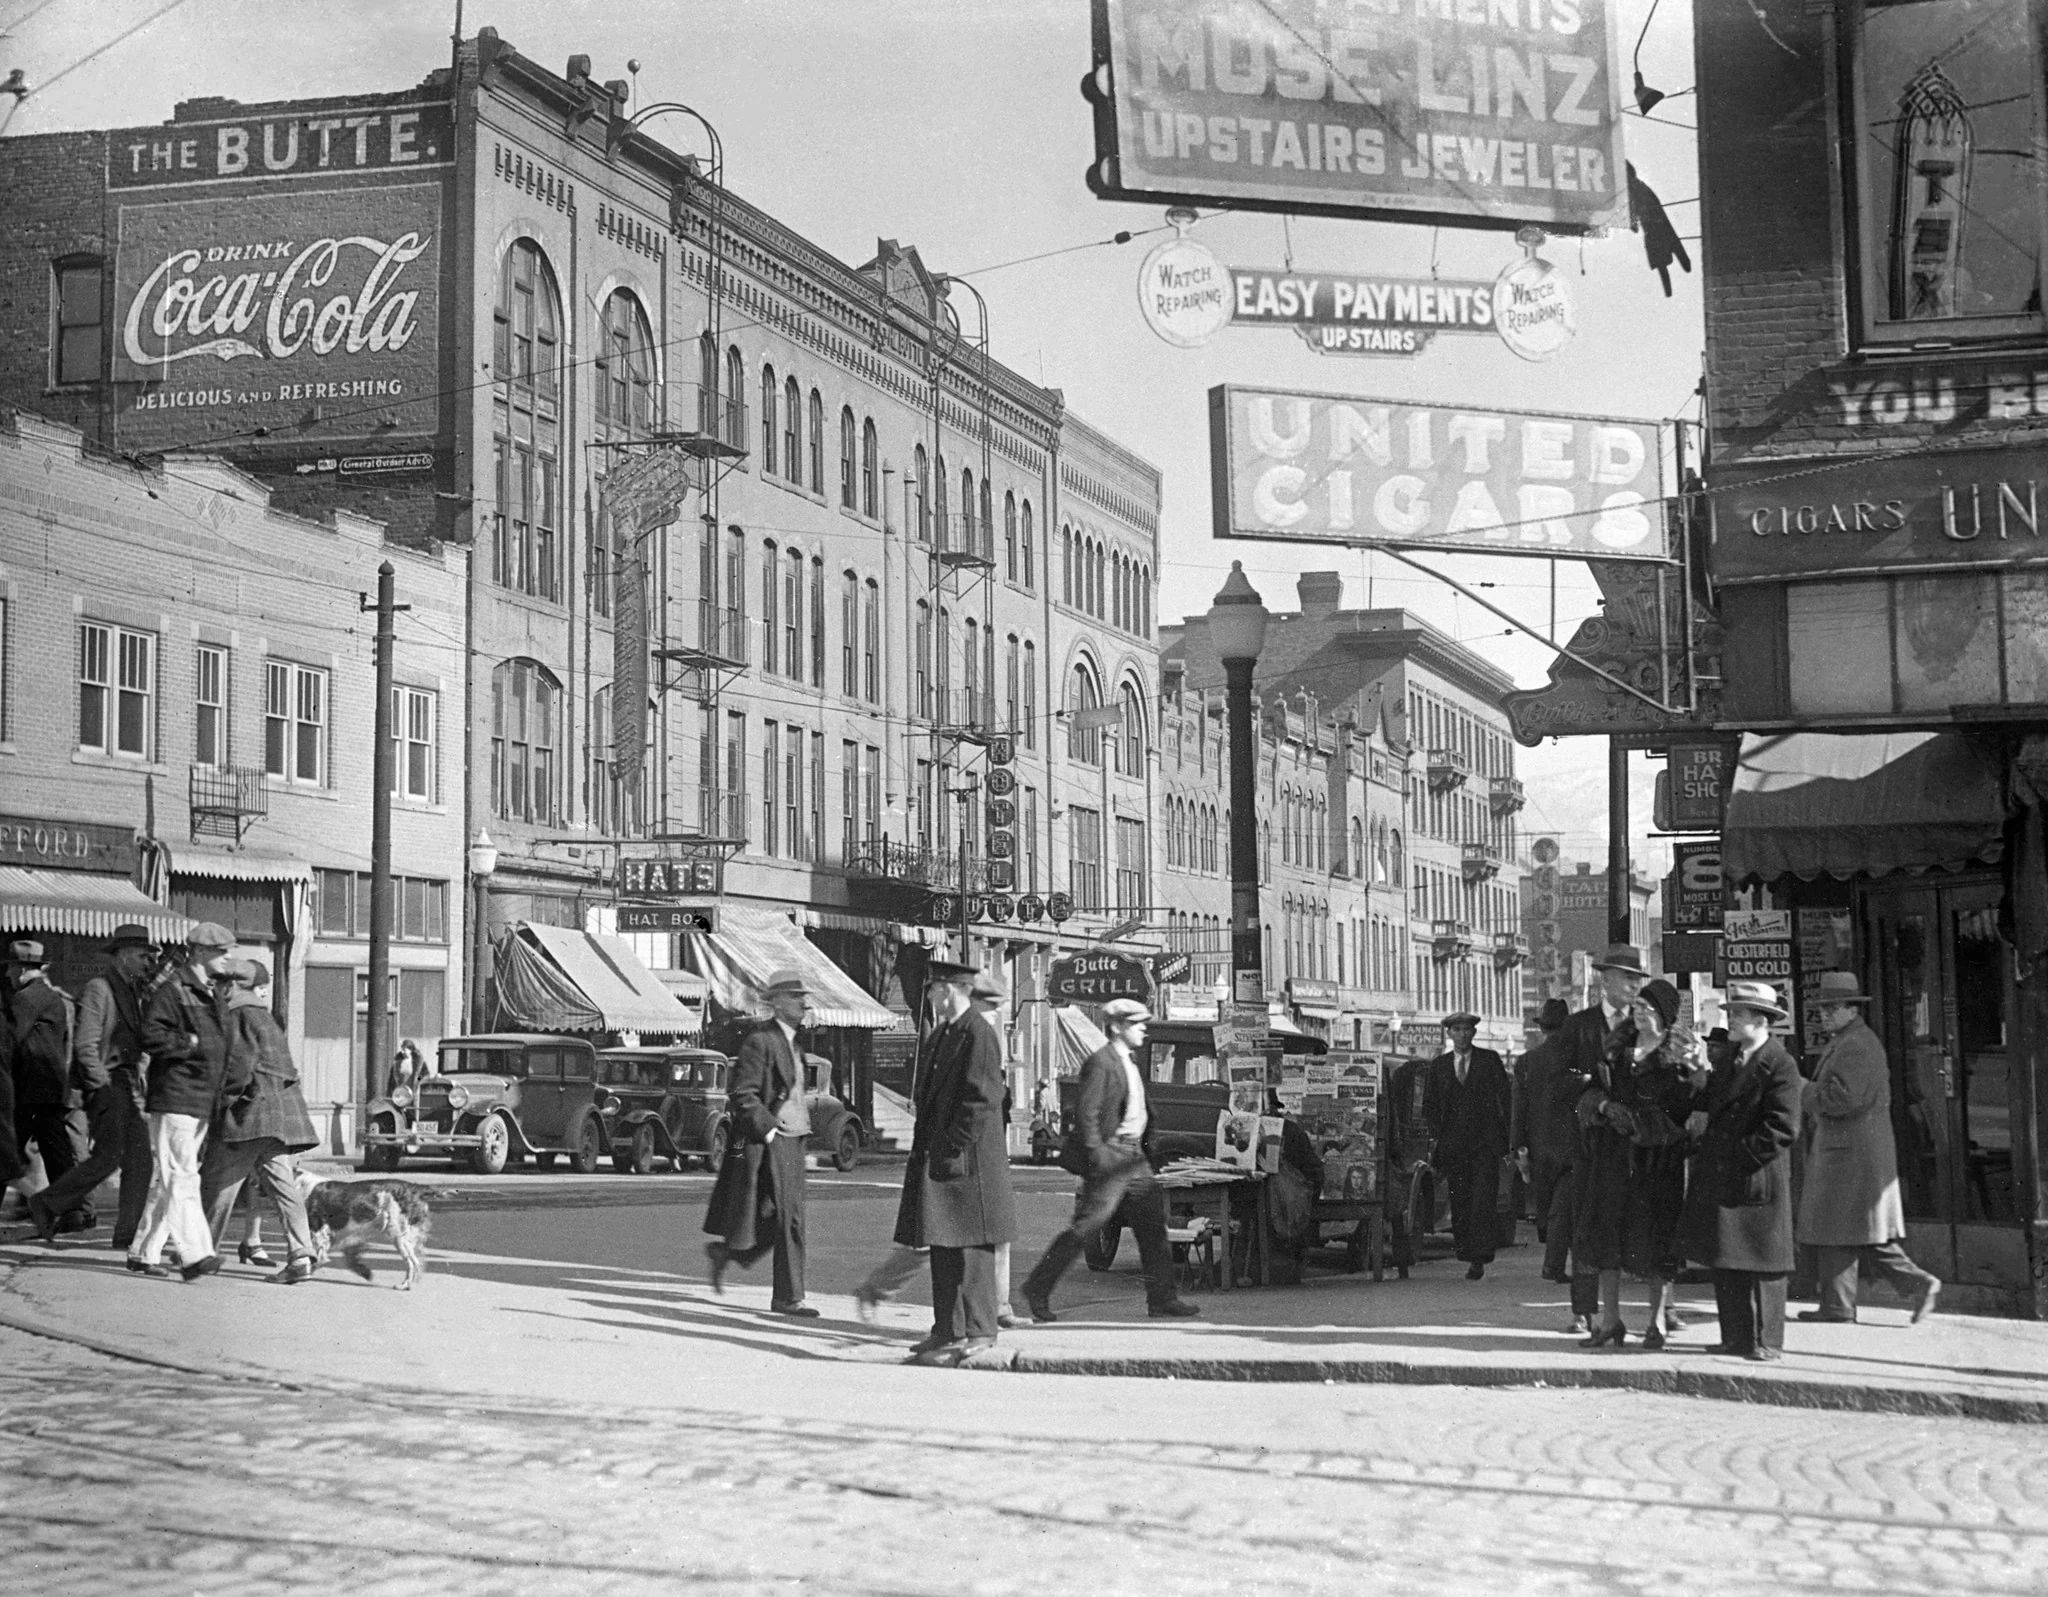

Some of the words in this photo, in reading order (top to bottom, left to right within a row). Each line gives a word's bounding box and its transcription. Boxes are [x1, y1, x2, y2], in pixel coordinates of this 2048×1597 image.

[1137, 10, 1382, 106] MOSE
[1416, 34, 1602, 127] LINZ
[128, 140, 198, 173] THE
[1142, 110, 1387, 176] UPSTAIRS
[1401, 131, 1606, 194] JEWELER
[204, 241, 295, 263] DRINK
[1156, 288, 1224, 314] REPAIRING
[1236, 275, 1318, 317] EASY
[1333, 281, 1493, 325] PAYMENTS
[135, 389, 233, 411] DELICIOUS
[237, 390, 272, 405] AND
[278, 378, 403, 403] REFRESHING
[1828, 377, 1956, 425] YOU
[1247, 397, 1646, 485] UNITED
[1252, 463, 1651, 548] CIGARS
[1751, 499, 1908, 537] CIGARS
[1939, 479, 2040, 541] UN
[624, 862, 716, 893] HATS
[628, 913, 659, 927] HAT
[671, 913, 704, 927] BO
[1073, 956, 1119, 973] Butte
[1726, 942, 1791, 958] CHESTERFIELD
[1727, 961, 1753, 976] OLD
[1755, 960, 1791, 976] GOLD
[1059, 978, 1139, 995] GRILL
[1399, 1034, 1442, 1045] SIGNS
